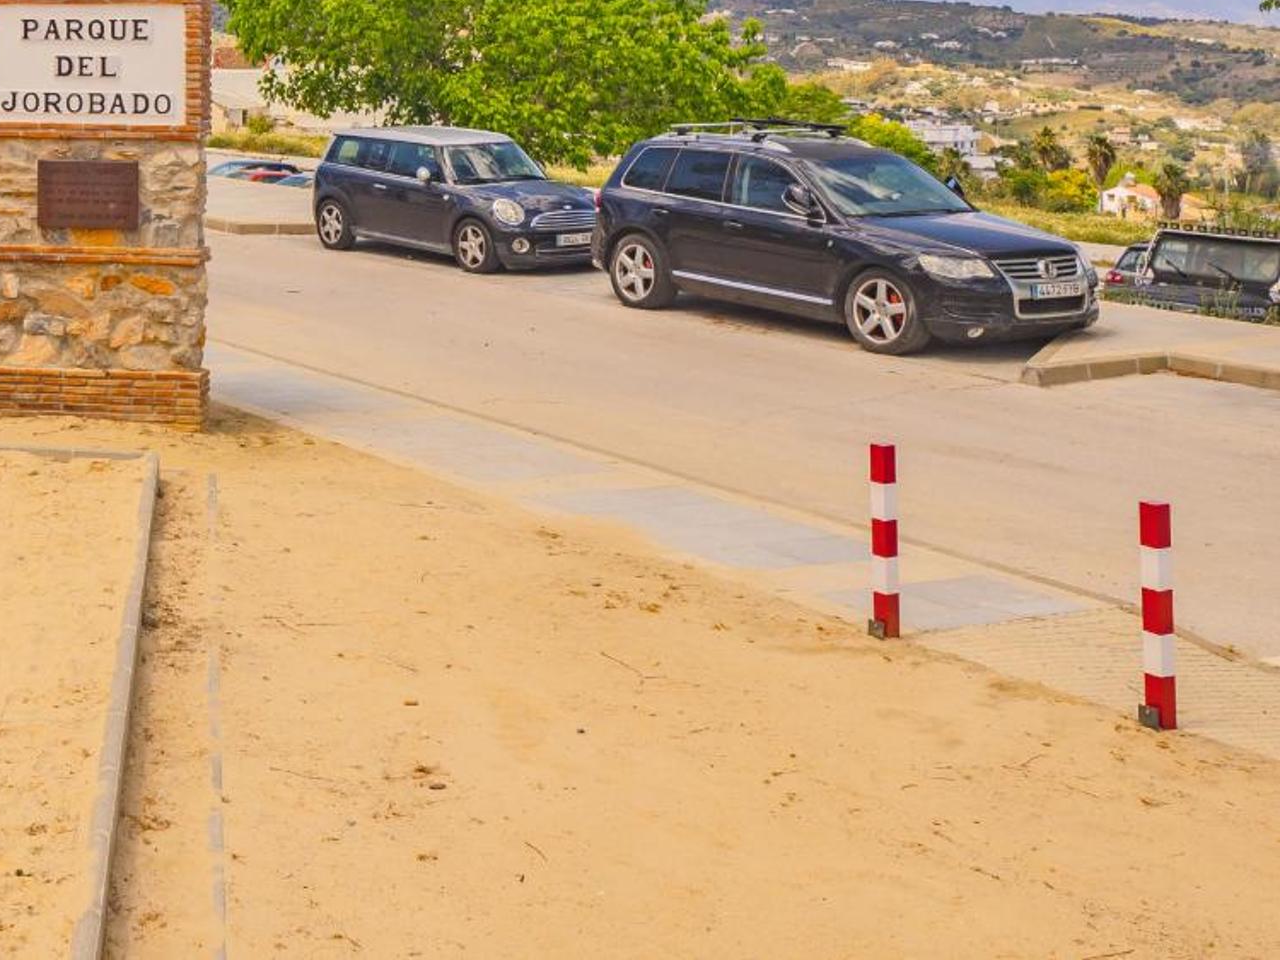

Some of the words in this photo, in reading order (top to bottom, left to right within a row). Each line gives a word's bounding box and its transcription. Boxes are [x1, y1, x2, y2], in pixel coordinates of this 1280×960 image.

[20, 18, 149, 41] PARQUE
[55, 55, 117, 78] DEL
[0, 91, 172, 115] JOROBADO
